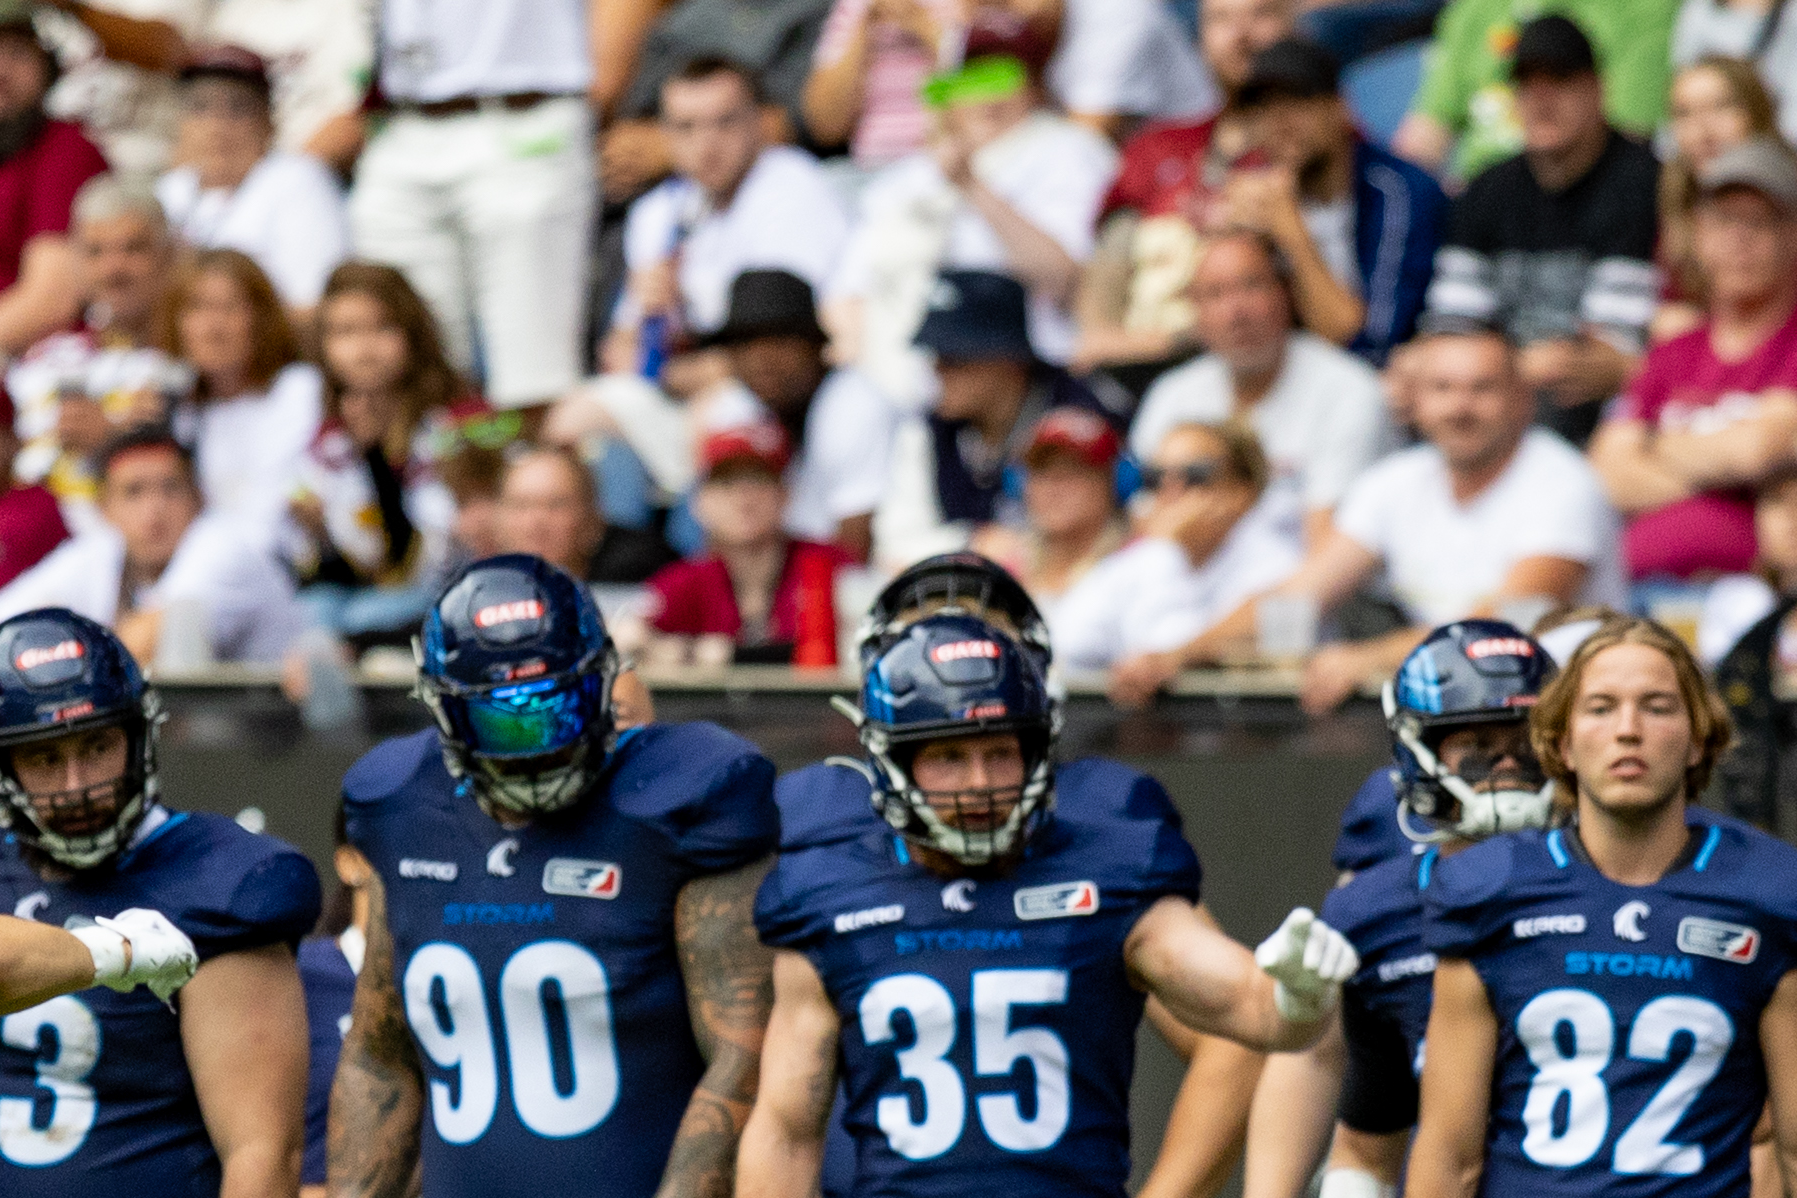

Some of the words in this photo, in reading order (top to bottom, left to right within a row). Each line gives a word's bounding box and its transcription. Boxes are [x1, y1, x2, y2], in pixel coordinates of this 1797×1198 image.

[403, 937, 621, 1146] 90
[1564, 950, 1693, 981] STORM
[858, 967, 1072, 1161] 35
[1516, 987, 1735, 1176] 82
